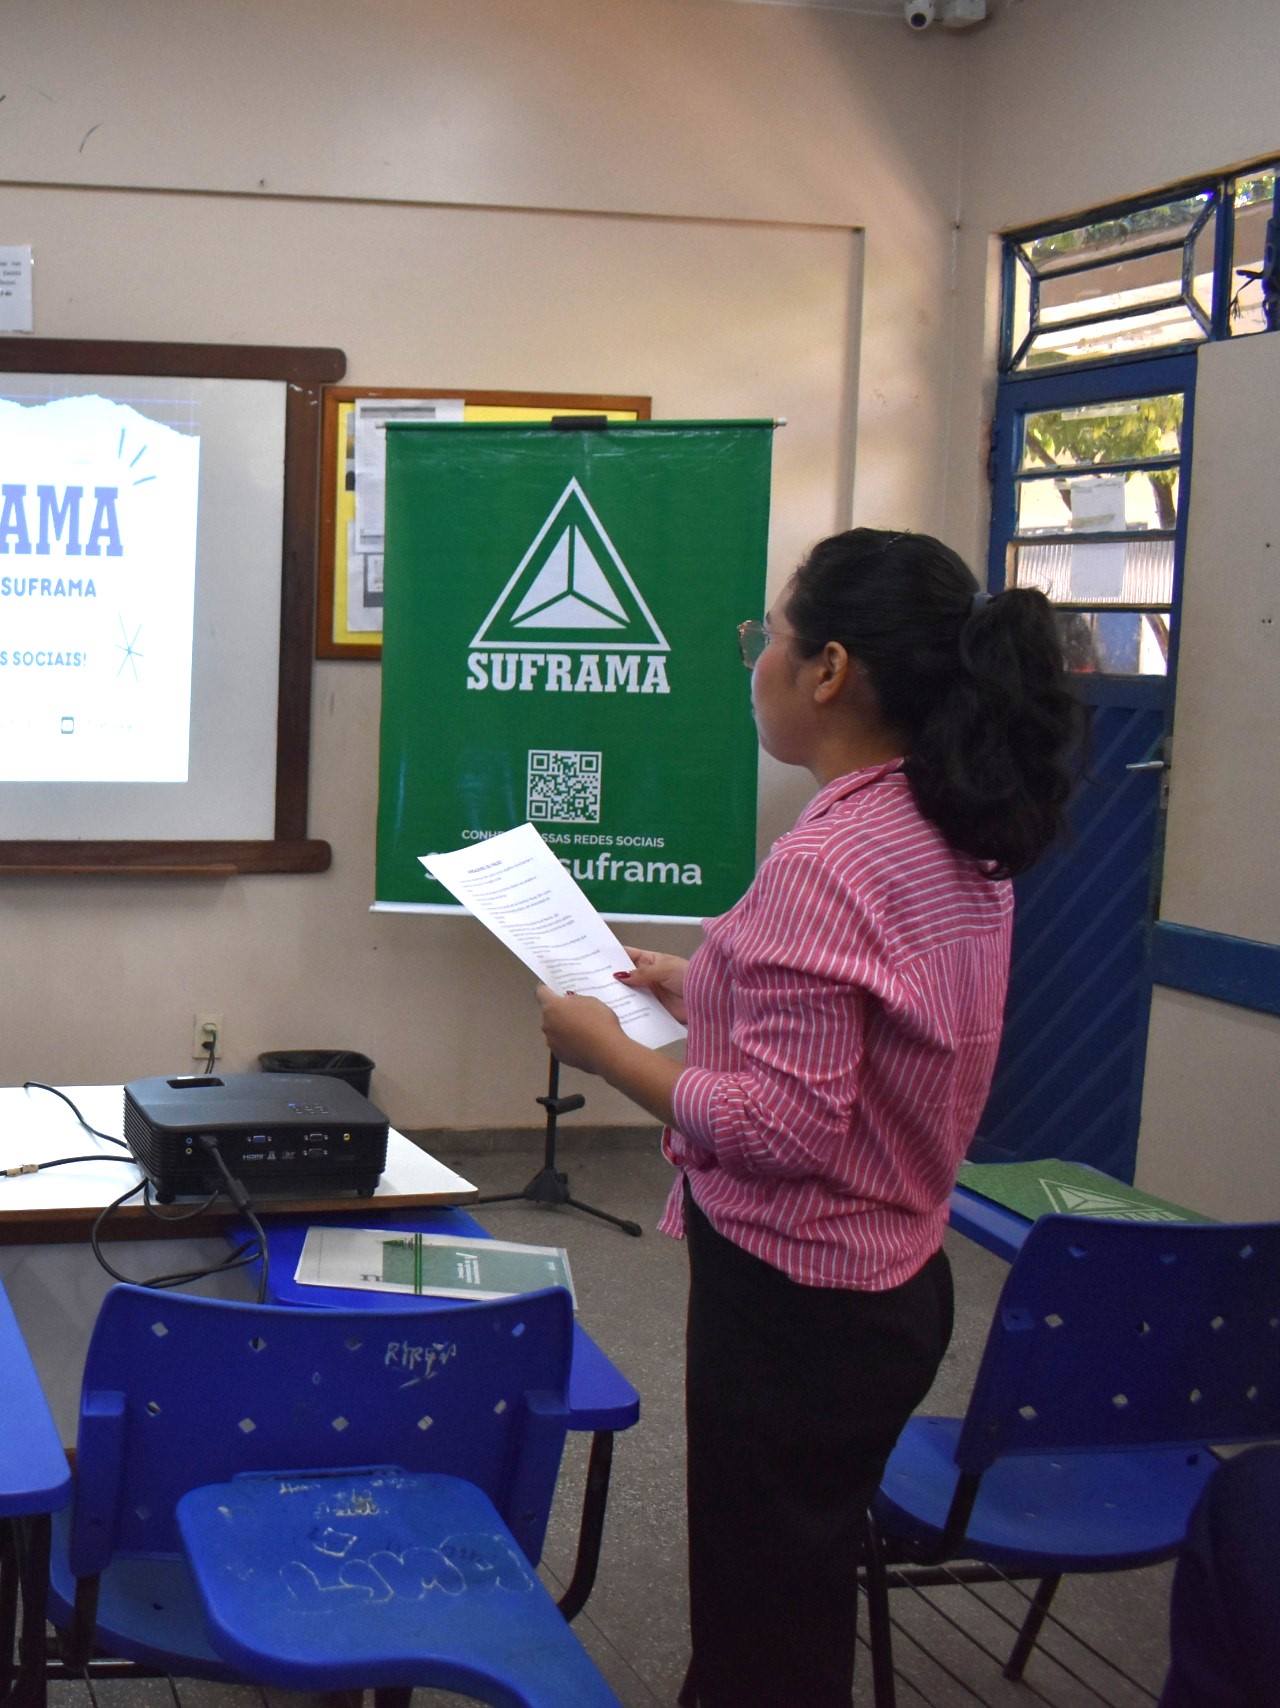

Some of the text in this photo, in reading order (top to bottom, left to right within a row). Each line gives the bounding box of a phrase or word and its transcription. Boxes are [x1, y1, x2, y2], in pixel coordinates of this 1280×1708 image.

[12, 651, 88, 667] SOCIAIS!
[467, 651, 671, 694] SUFRAMA
[540, 832, 571, 845] SSAS
[573, 834, 614, 846] REDES
[615, 835, 665, 848] SOCIAIS
